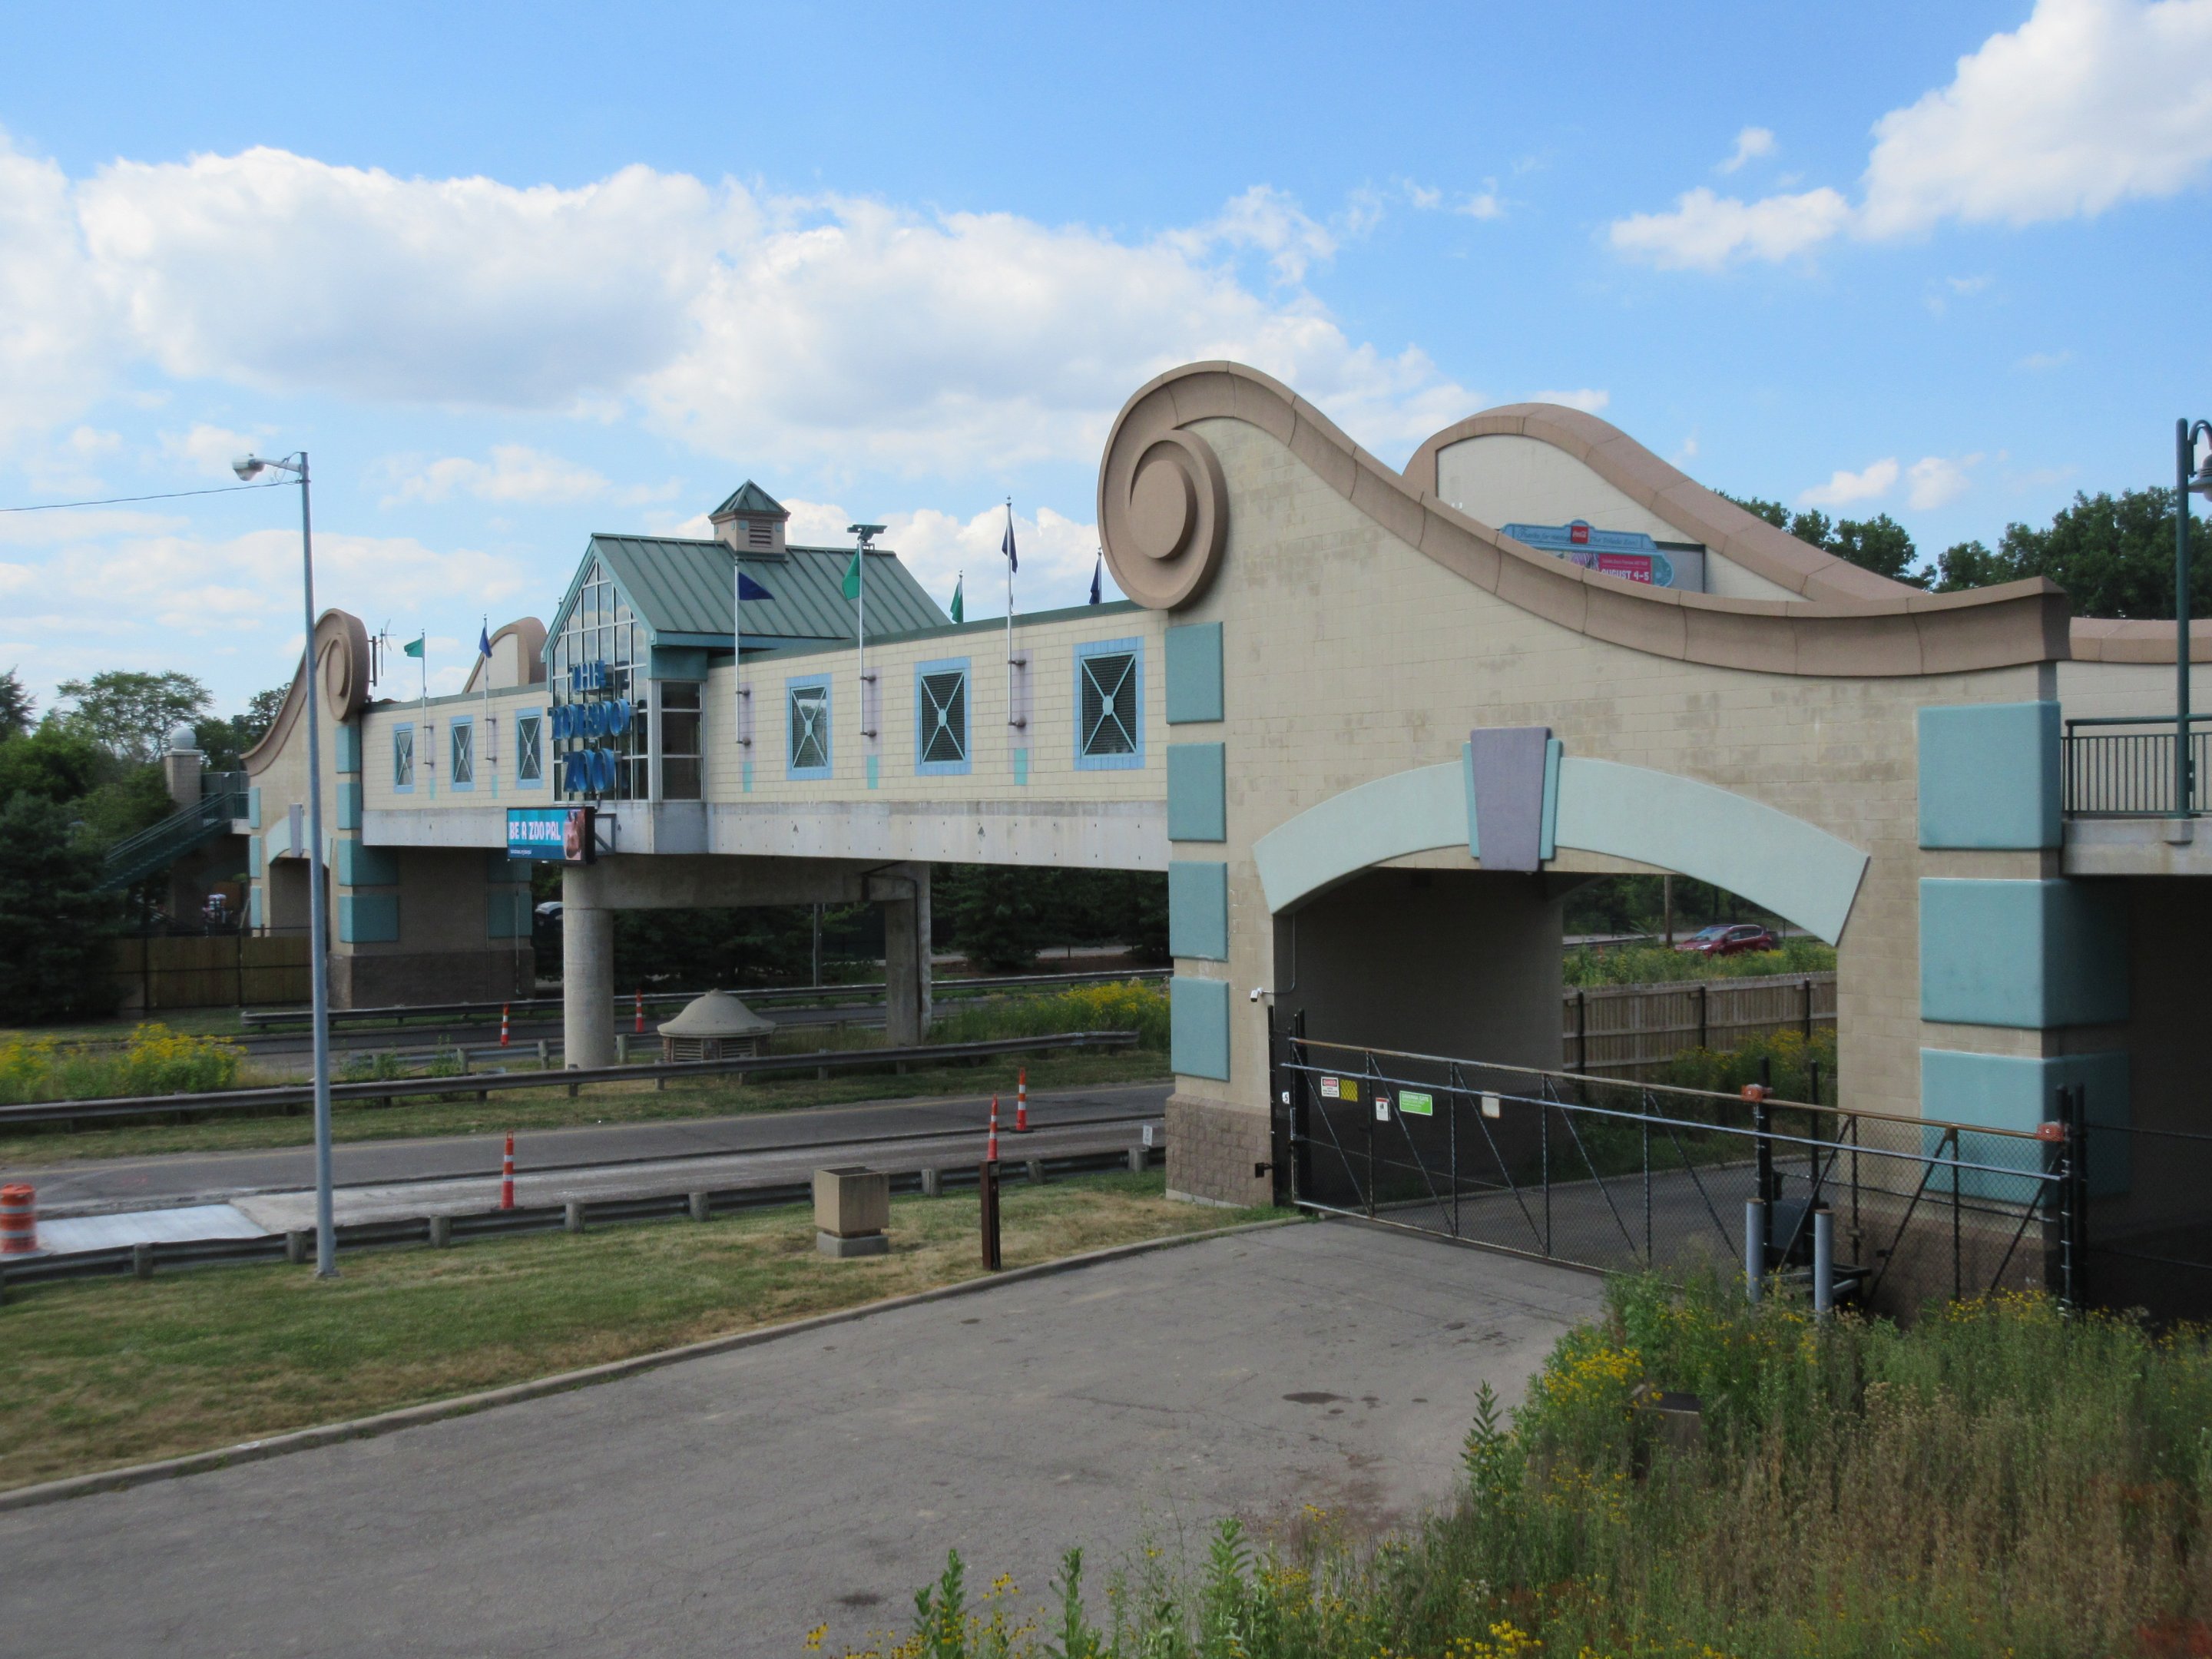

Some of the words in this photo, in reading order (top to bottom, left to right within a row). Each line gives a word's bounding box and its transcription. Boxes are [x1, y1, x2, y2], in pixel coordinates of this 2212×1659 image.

[1601, 568, 1631, 580] AUGUST
[569, 660, 606, 693] THE
[548, 698, 630, 741] TOLEDO
[562, 748, 615, 793] ZOO
[509, 822, 520, 840] BE
[522, 821, 528, 840] A
[528, 821, 545, 841] ZOO
[545, 821, 561, 841] PAL
